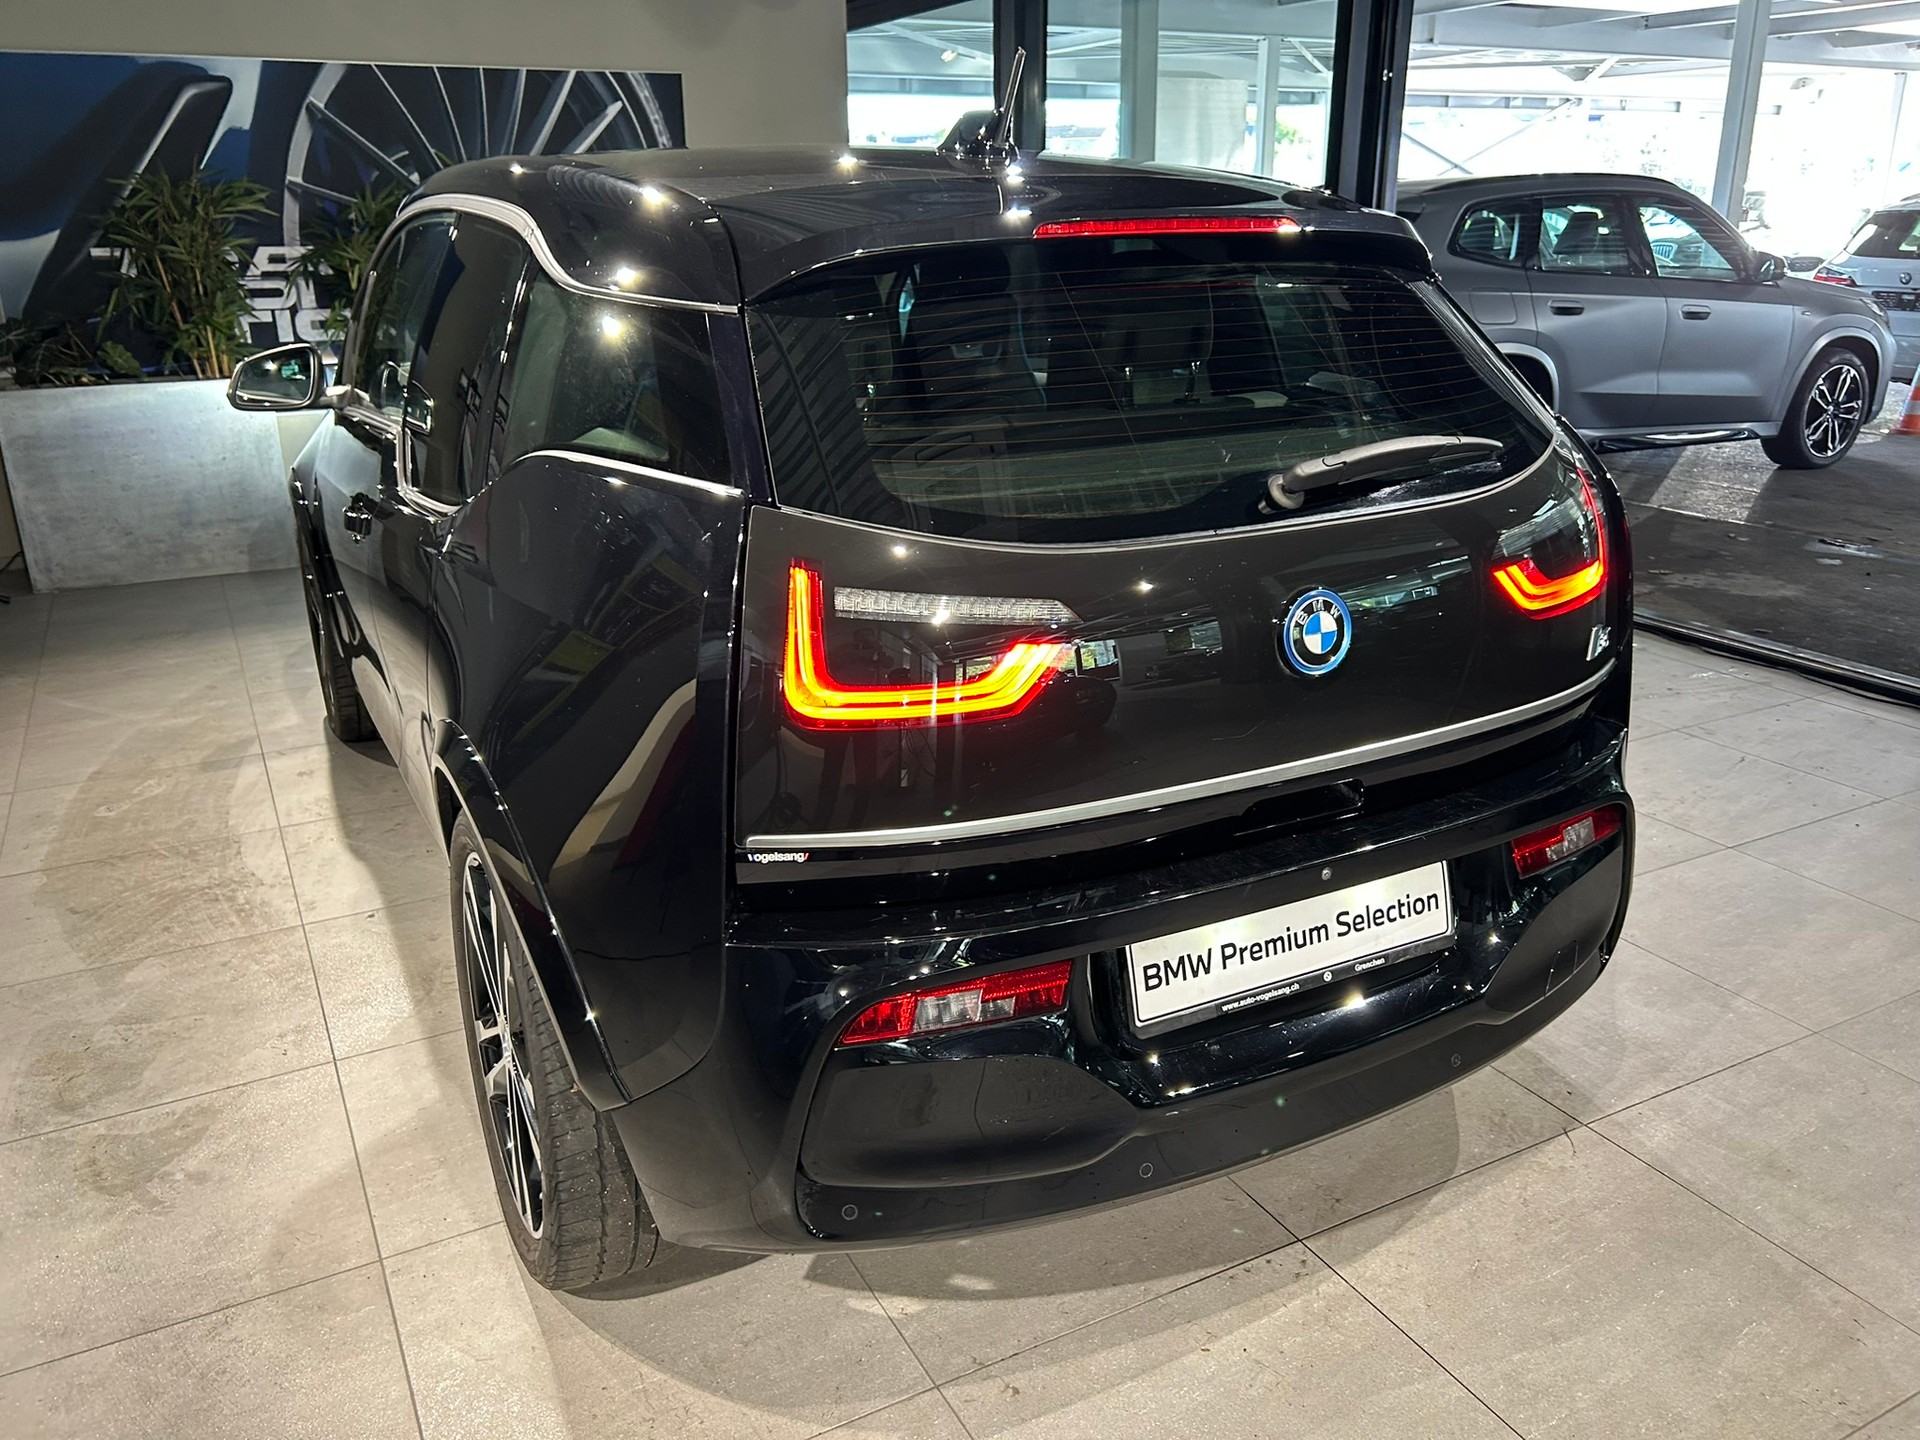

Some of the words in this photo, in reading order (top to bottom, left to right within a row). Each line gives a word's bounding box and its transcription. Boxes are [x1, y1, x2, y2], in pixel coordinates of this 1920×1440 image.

[1296, 600, 1341, 626] BMW
[1143, 948, 1212, 991] BMW
[1221, 923, 1329, 969] Premium
[1336, 893, 1439, 937] Selection
[1354, 957, 1386, 972] Grenchen
[1221, 983, 1300, 1012] www.auto-vogelsang.ch
